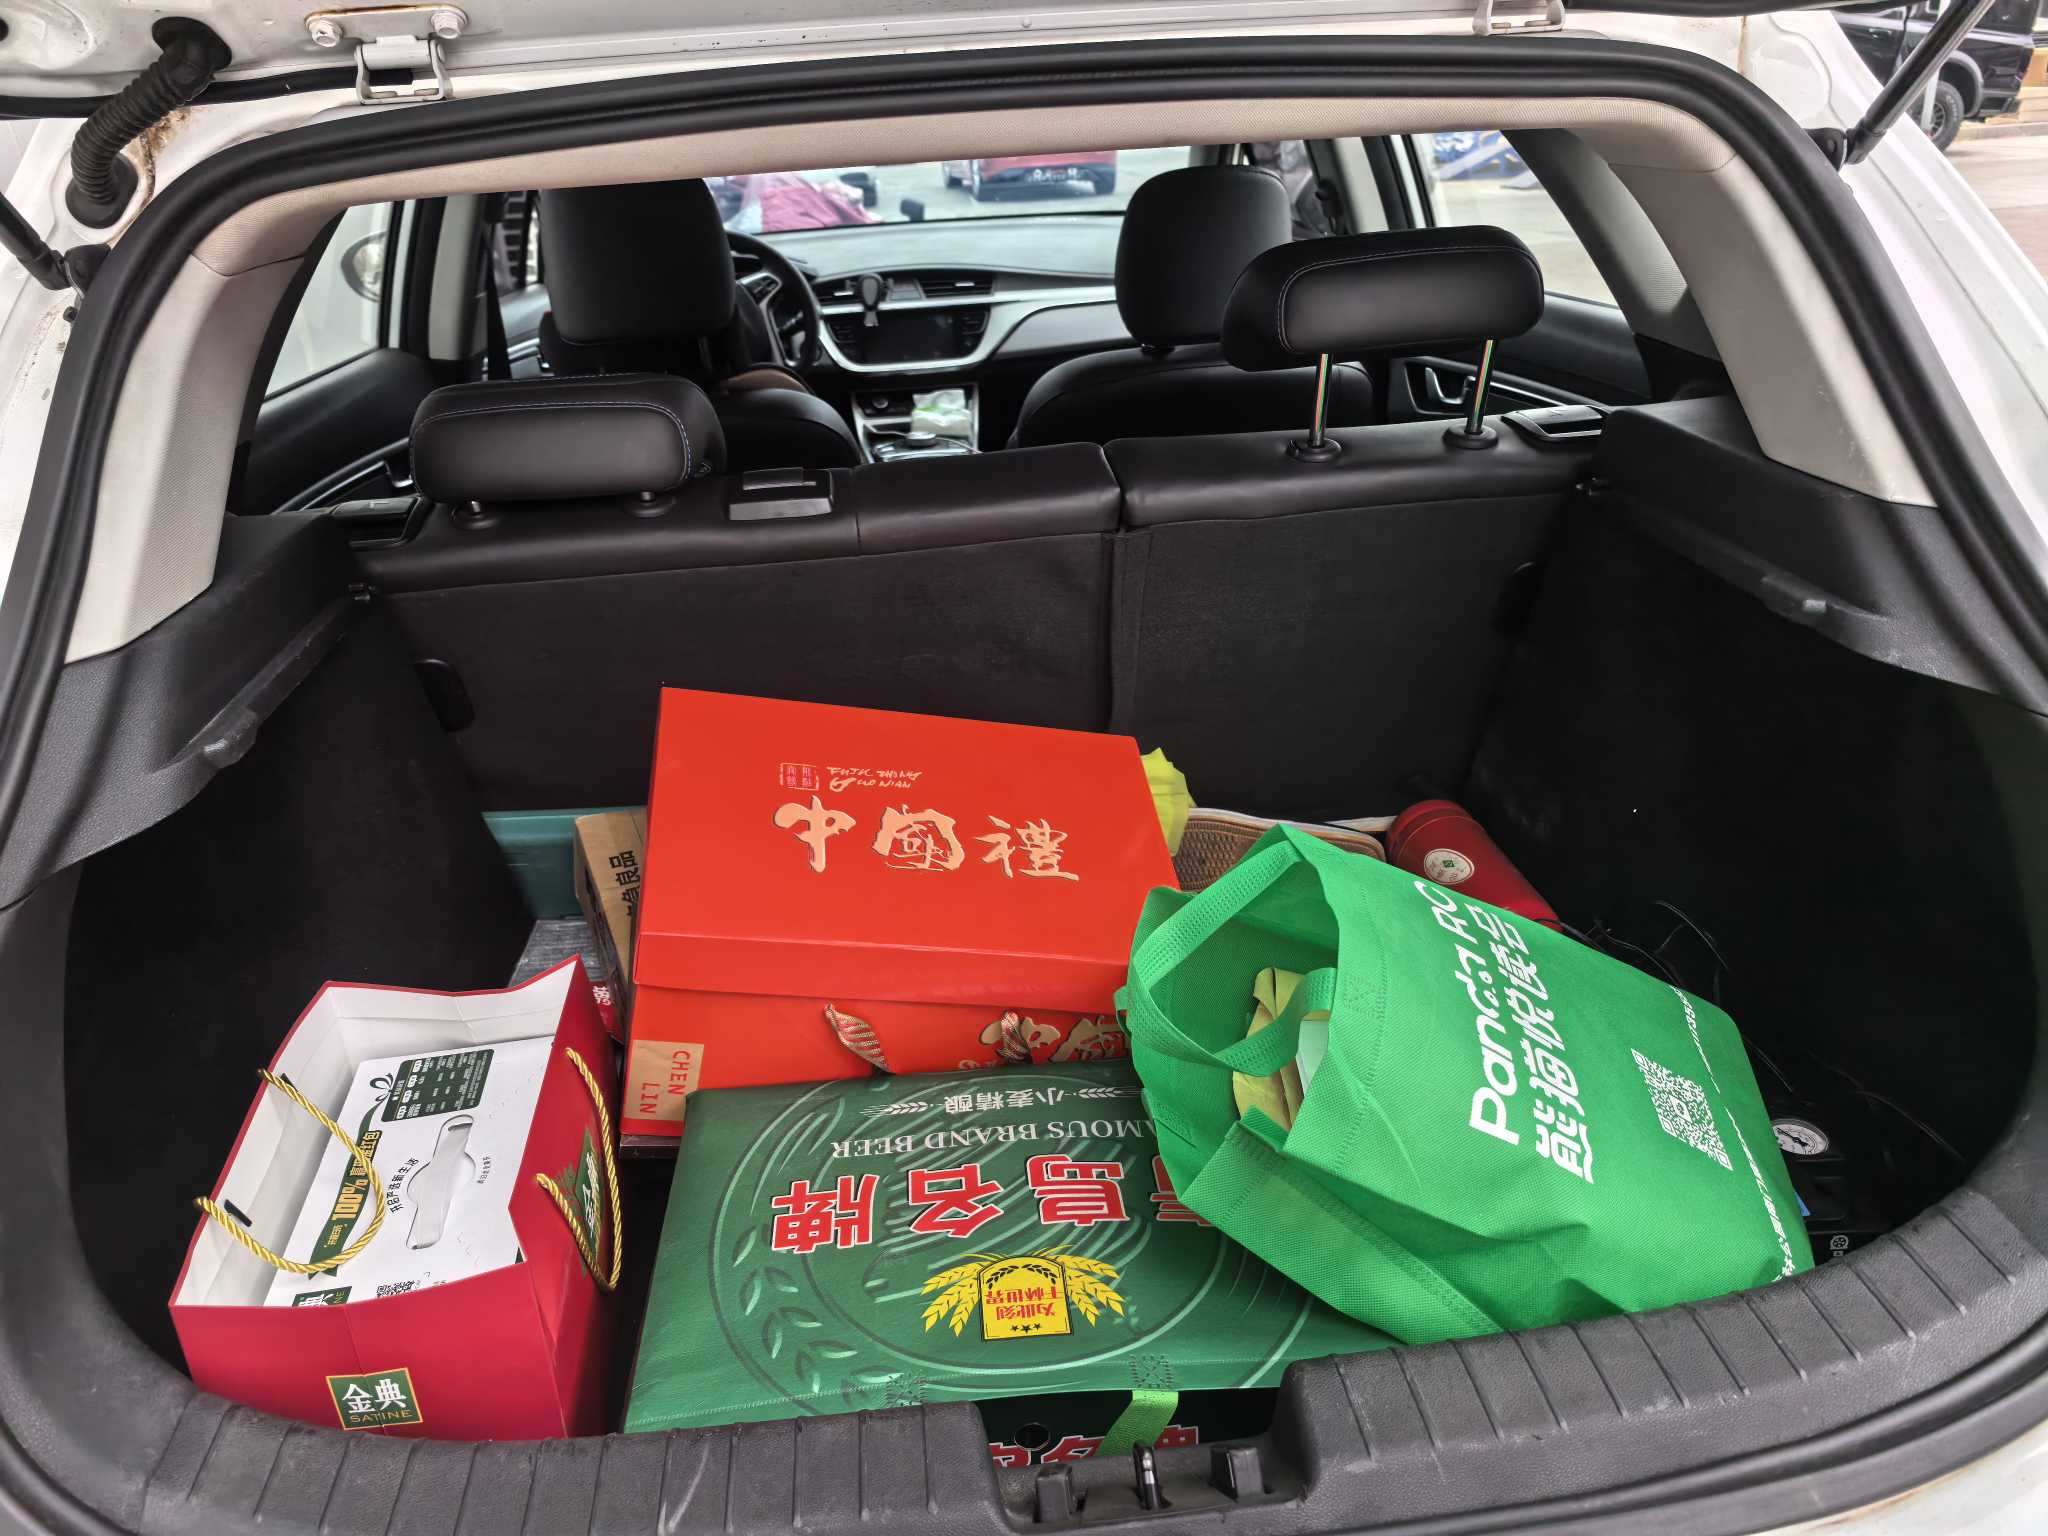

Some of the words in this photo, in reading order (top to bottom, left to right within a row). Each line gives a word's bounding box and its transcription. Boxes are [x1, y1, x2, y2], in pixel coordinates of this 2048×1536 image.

[667, 1050, 692, 1096] CHEN
[639, 1081, 661, 1115] LIN
[945, 1086, 1065, 1116] 小麦精酿
[924, 1122, 1037, 1150] BRAND
[1048, 1119, 1156, 1140] MOUS
[831, 1136, 914, 1159] BEER
[331, 1179, 368, 1221] 100%
[342, 1378, 407, 1413] 金典
[350, 1409, 413, 1424] SATINE
